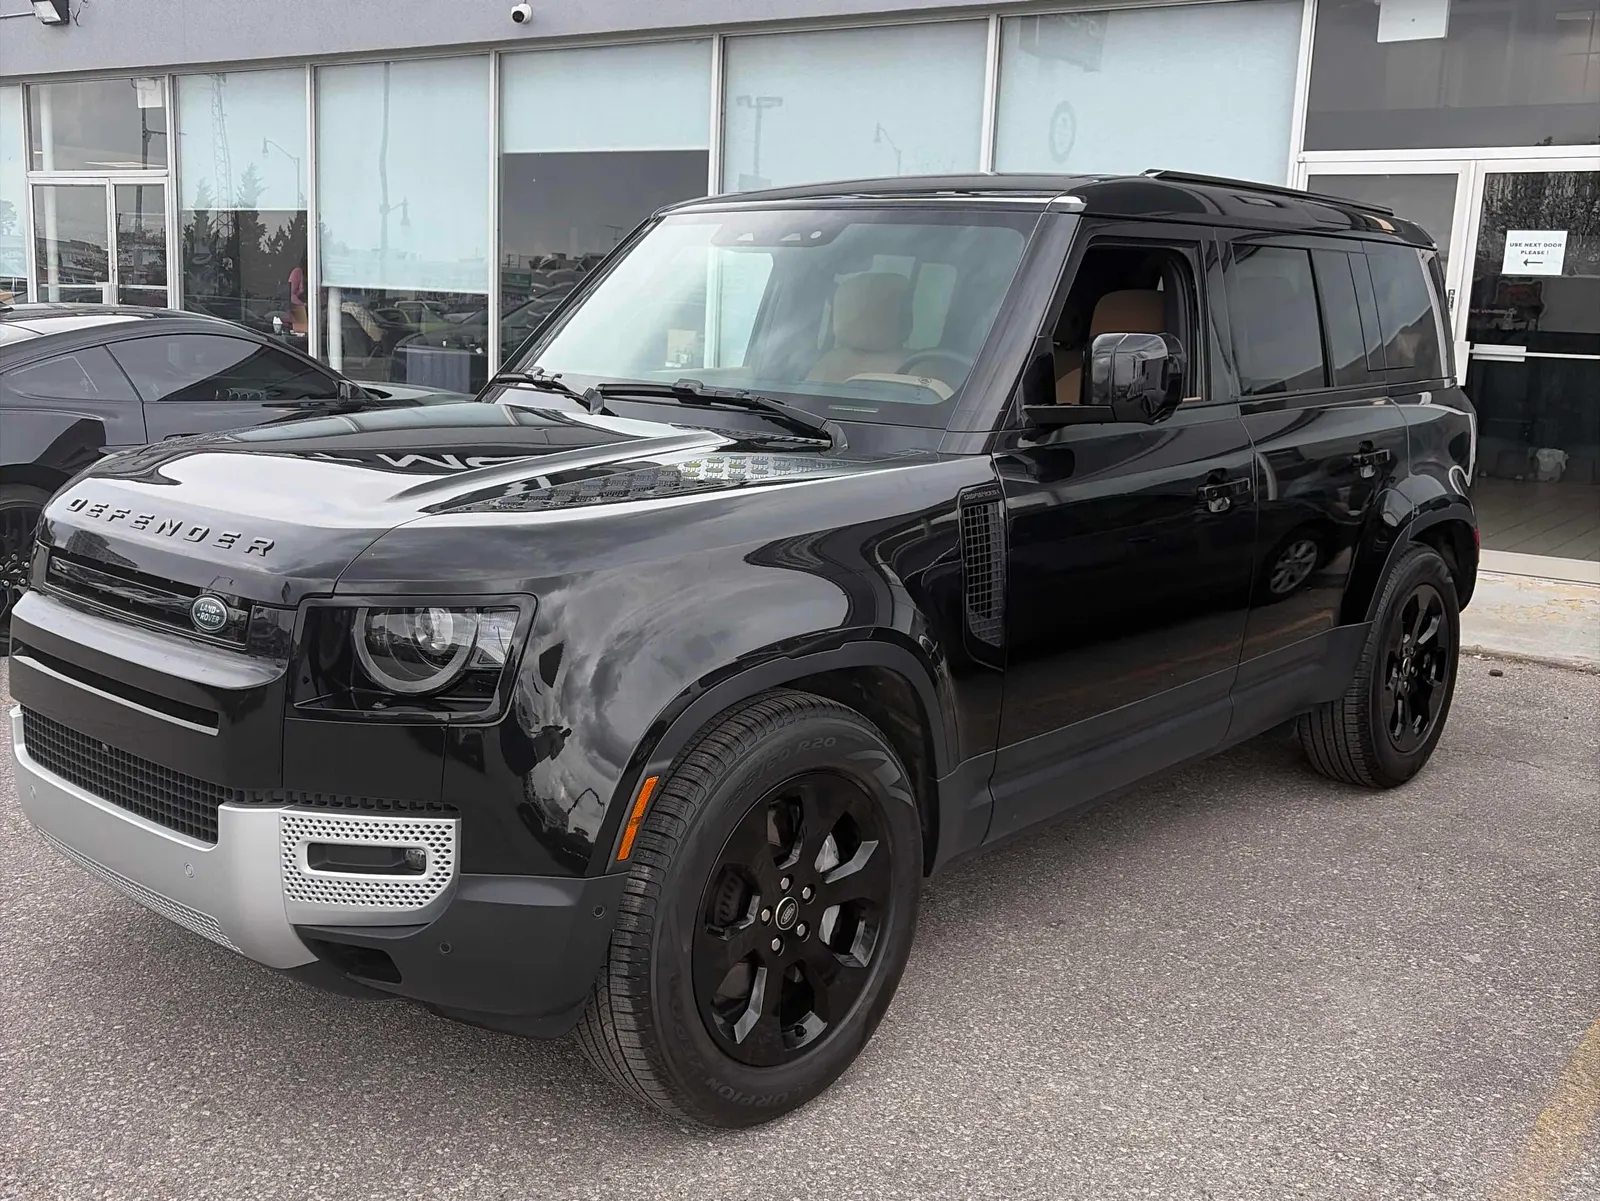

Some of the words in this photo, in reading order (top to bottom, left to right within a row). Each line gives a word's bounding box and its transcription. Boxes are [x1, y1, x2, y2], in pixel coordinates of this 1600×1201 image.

[66, 497, 276, 557] DEFENDER
[199, 603, 217, 614] LAND
[199, 612, 221, 624] ROVER
